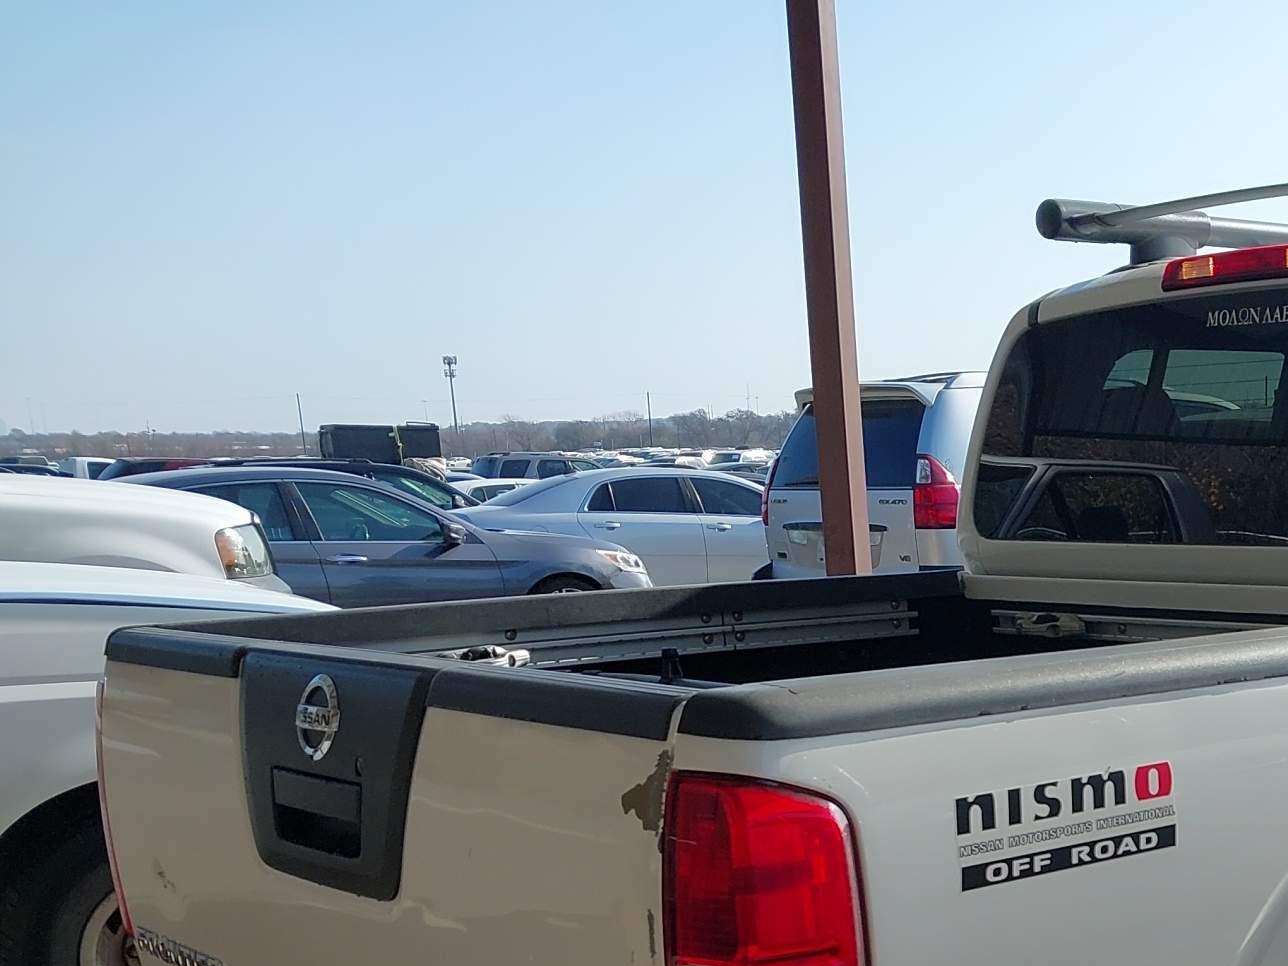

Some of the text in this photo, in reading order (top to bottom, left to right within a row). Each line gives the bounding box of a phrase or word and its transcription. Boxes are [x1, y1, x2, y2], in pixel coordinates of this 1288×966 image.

[960, 804, 1176, 858] NISSAN MOTORSPORTS INTERNATIONAL
[985, 831, 1159, 883] OFF ROAD
